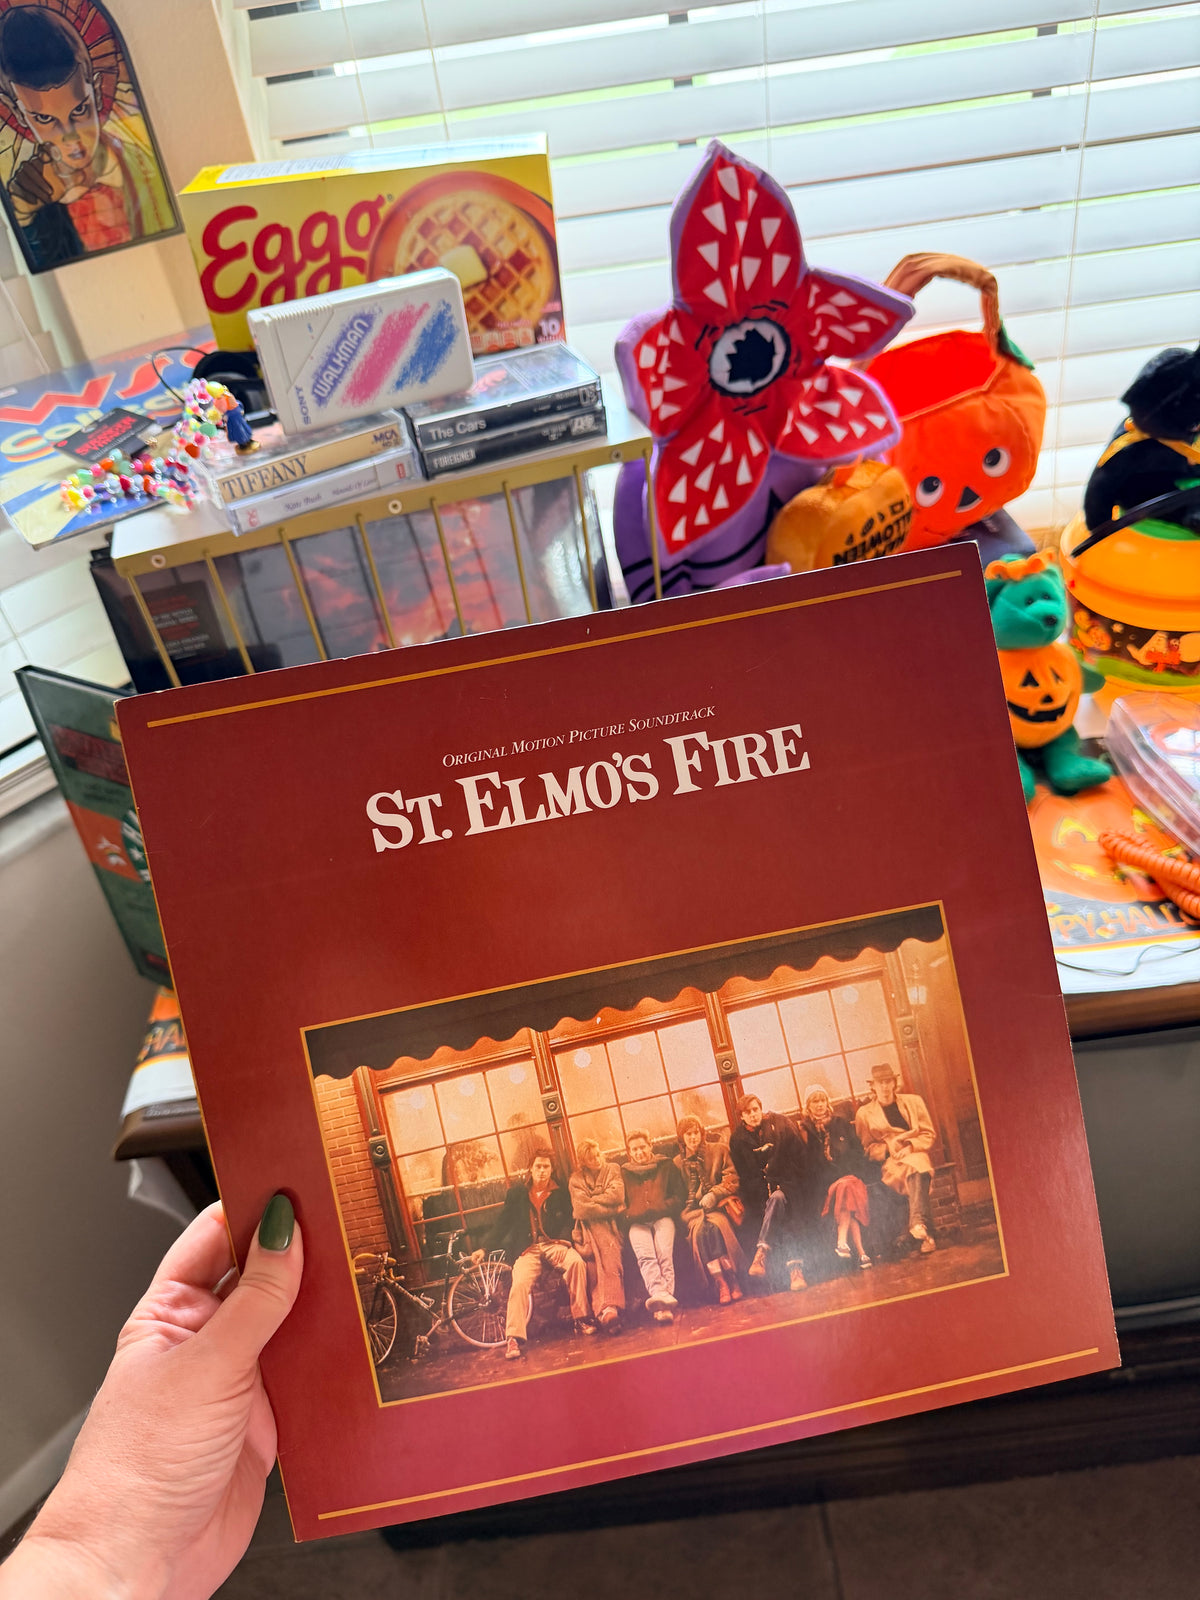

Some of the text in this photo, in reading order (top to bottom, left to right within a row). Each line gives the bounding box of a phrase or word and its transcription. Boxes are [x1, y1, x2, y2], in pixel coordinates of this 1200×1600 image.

[200, 195, 386, 314] Eggo
[538, 317, 561, 338] 10
[313, 318, 370, 397] WALKMAN
[428, 419, 487, 441] The Cars
[222, 455, 309, 500] TIFFANY
[433, 448, 477, 469] FOREIGNER
[441, 705, 716, 769] ORIGINAL MOTION PICTURE SOUNDTRACK
[365, 723, 811, 853] ST. ELMO'S FIRE
[1051, 903, 1187, 940] PY HALL
